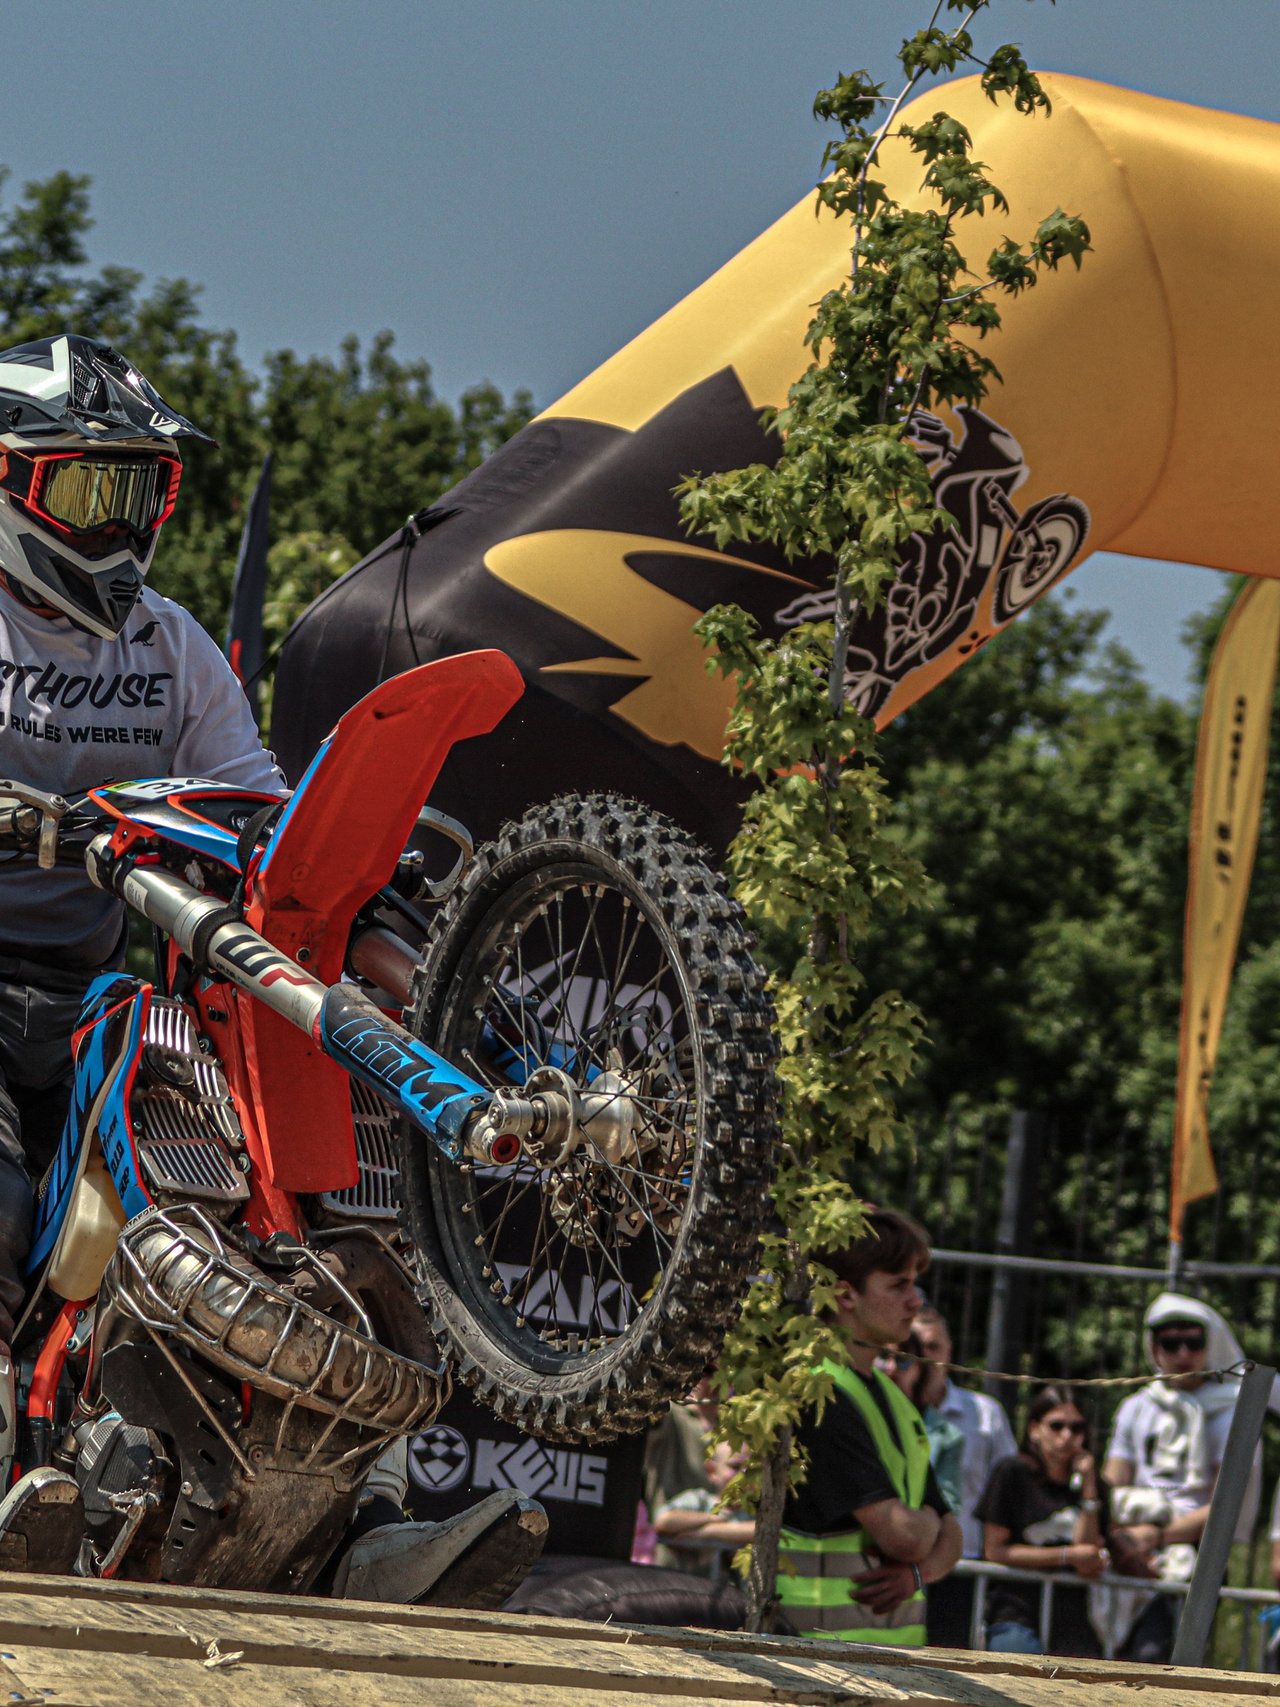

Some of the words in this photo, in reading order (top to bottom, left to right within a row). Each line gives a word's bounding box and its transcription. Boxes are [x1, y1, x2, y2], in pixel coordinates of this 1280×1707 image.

[10, 716, 62, 743] RULES
[66, 725, 130, 744] WERE
[133, 727, 163, 747] FEW
[214, 933, 324, 988] WP
[331, 1016, 469, 1113] KTM
